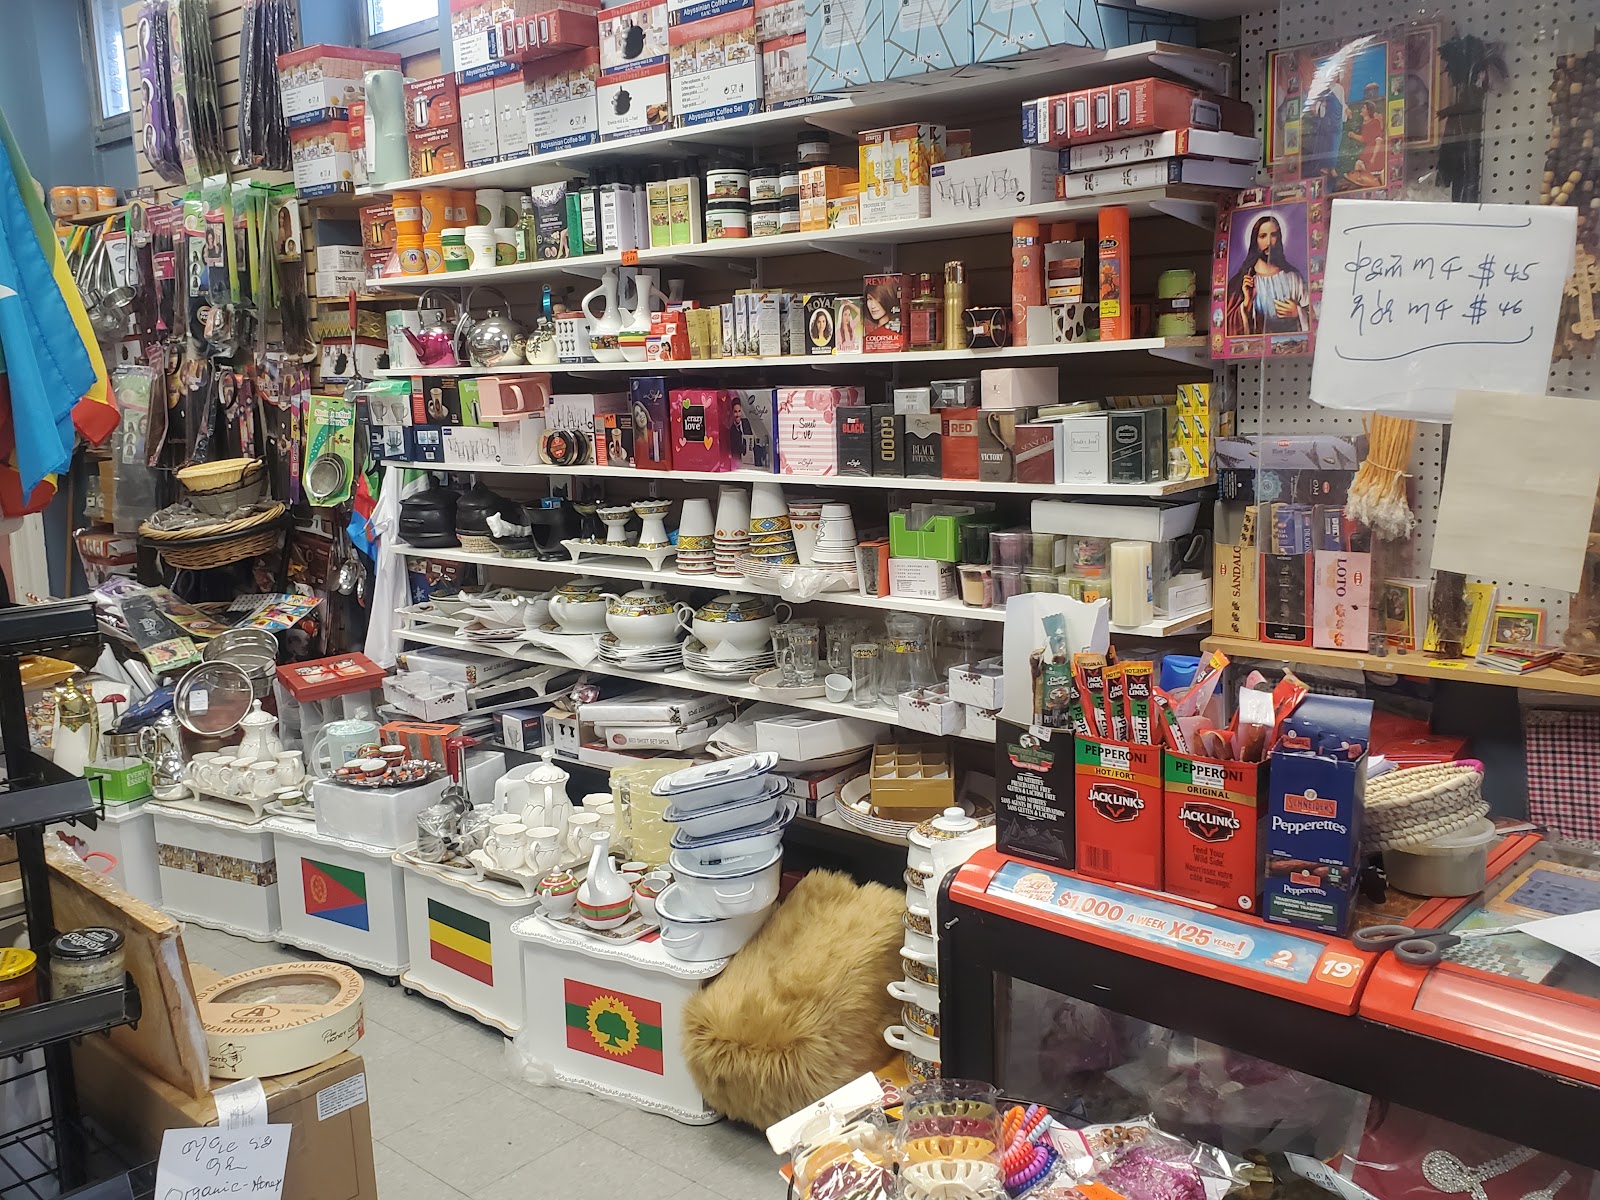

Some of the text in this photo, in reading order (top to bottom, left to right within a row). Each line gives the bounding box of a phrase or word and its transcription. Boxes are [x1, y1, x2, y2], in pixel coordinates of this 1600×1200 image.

[1468, 254, 1496, 290] $
[1504, 261, 1540, 282] 45
[866, 277, 900, 286] REVLON
[806, 297, 835, 312] ROYAL
[1462, 294, 1488, 325] $
[1498, 300, 1523, 317] 46
[685, 420, 700, 430] love
[686, 415, 703, 424] crazy
[799, 418, 816, 429] Sweet
[842, 424, 864, 434] BLACK
[951, 423, 972, 433] RED
[881, 416, 895, 461] GOOD
[1021, 436, 1050, 451] SENSUAL
[912, 445, 935, 455] BLACK
[981, 453, 1003, 461] VICTORY
[1232, 546, 1242, 597] SANDALO
[1336, 558, 1347, 597] LOTO
[1085, 744, 1147, 764] PEPPERONI
[1095, 767, 1136, 780] HOT/FORT
[1176, 761, 1243, 782] PEPPERONI
[1088, 789, 1144, 809] JACK LINK'S
[1187, 785, 1230, 799] ORIGINAL
[1178, 808, 1240, 829] JACK LINK'S
[1272, 816, 1347, 835] Pepperettes
[1192, 845, 1225, 858] Feed Your
[1194, 855, 1208, 864] Wild
[1185, 863, 1233, 880] Nourrissez votre
[1284, 884, 1327, 897] Pepperettes
[1057, 891, 1124, 923] $1,000
[1126, 914, 1135, 922] A
[1137, 916, 1167, 930] WEEK
[1168, 921, 1213, 946] X25
[1276, 950, 1292, 965] 2
[288, 962, 342, 974] NATURAL
[261, 1012, 325, 1032] QUALITY
